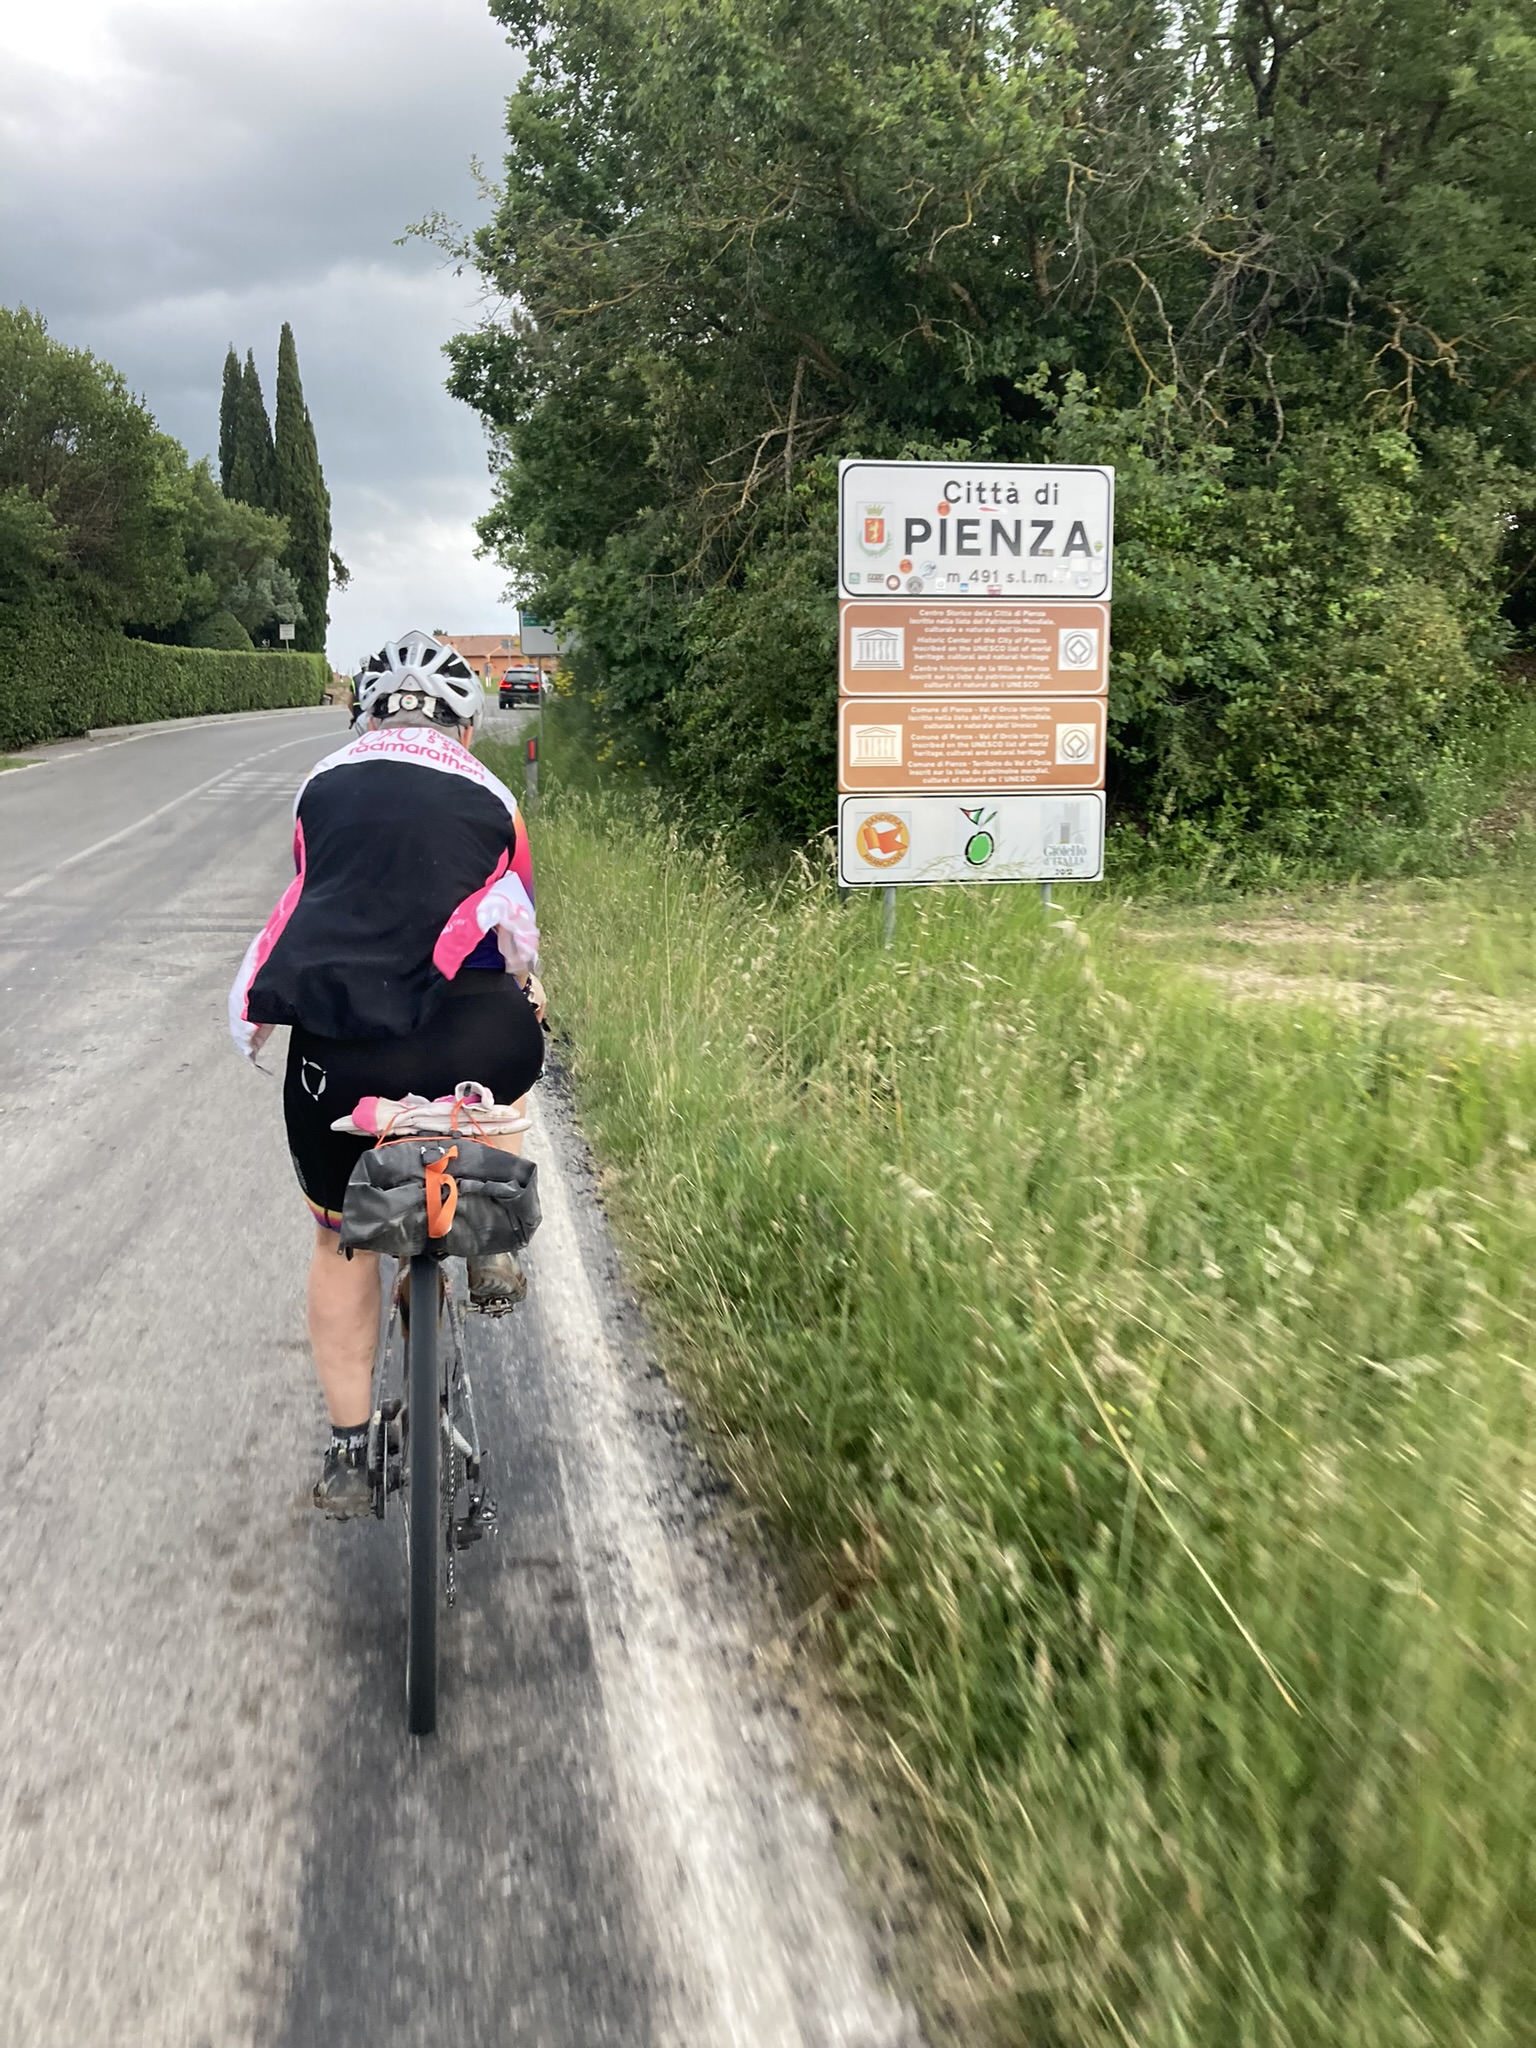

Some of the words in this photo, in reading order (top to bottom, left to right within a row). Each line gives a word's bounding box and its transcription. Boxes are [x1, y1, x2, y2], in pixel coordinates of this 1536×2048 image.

[943, 480, 1019, 504] Città
[1035, 482, 1059, 505] di
[904, 518, 1093, 557] PIENZA
[946, 574, 960, 583] m
[969, 570, 999, 584] 491
[427, 735, 435, 744] 5
[348, 741, 486, 780] radmarathon
